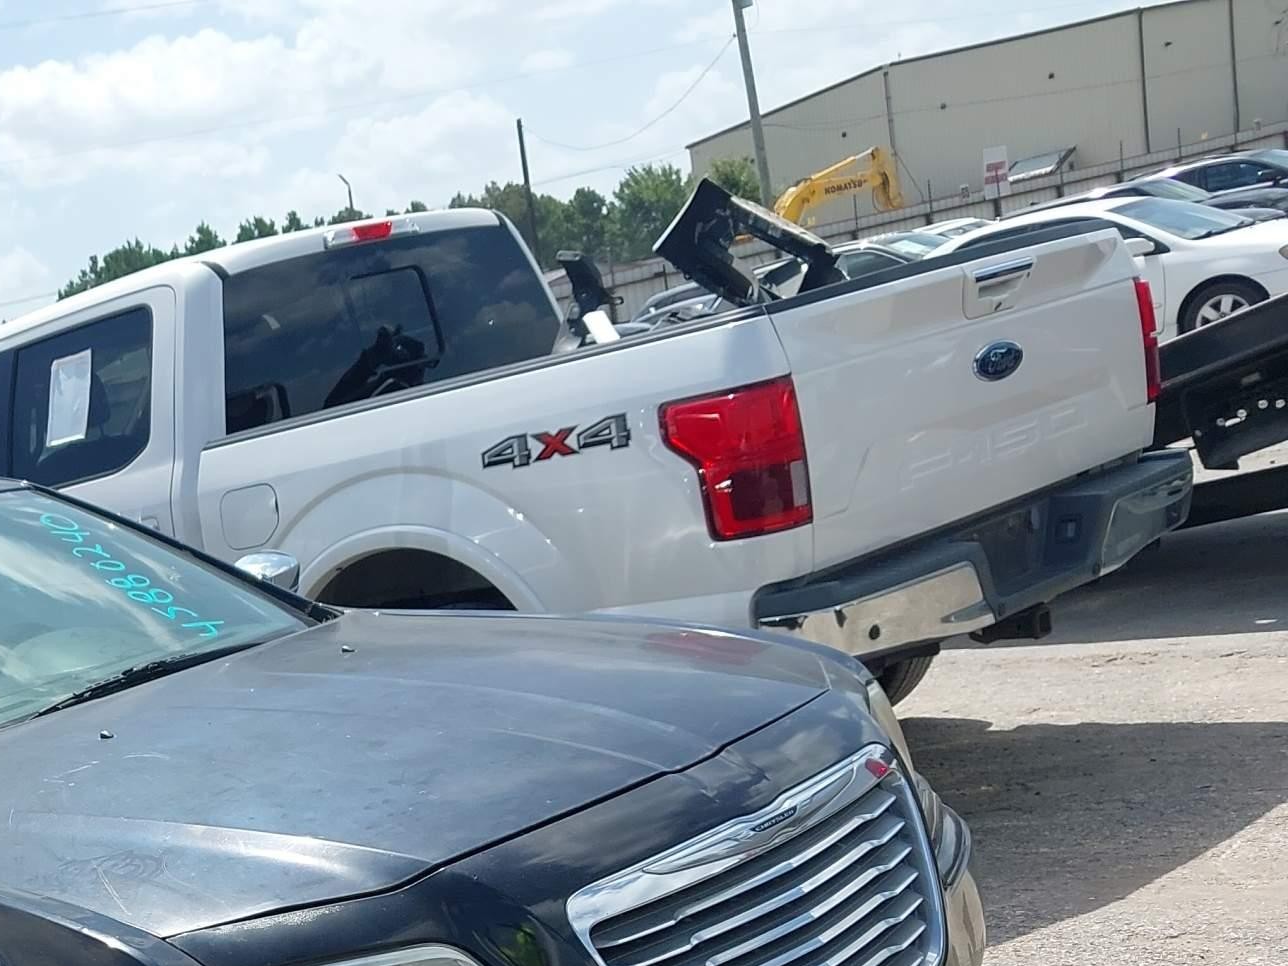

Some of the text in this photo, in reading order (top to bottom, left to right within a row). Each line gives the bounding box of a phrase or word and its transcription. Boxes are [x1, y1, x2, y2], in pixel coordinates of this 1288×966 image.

[824, 180, 863, 195] KOMATSU
[39, 511, 225, 638] 45880240
[754, 808, 795, 832] CHRYSLER
